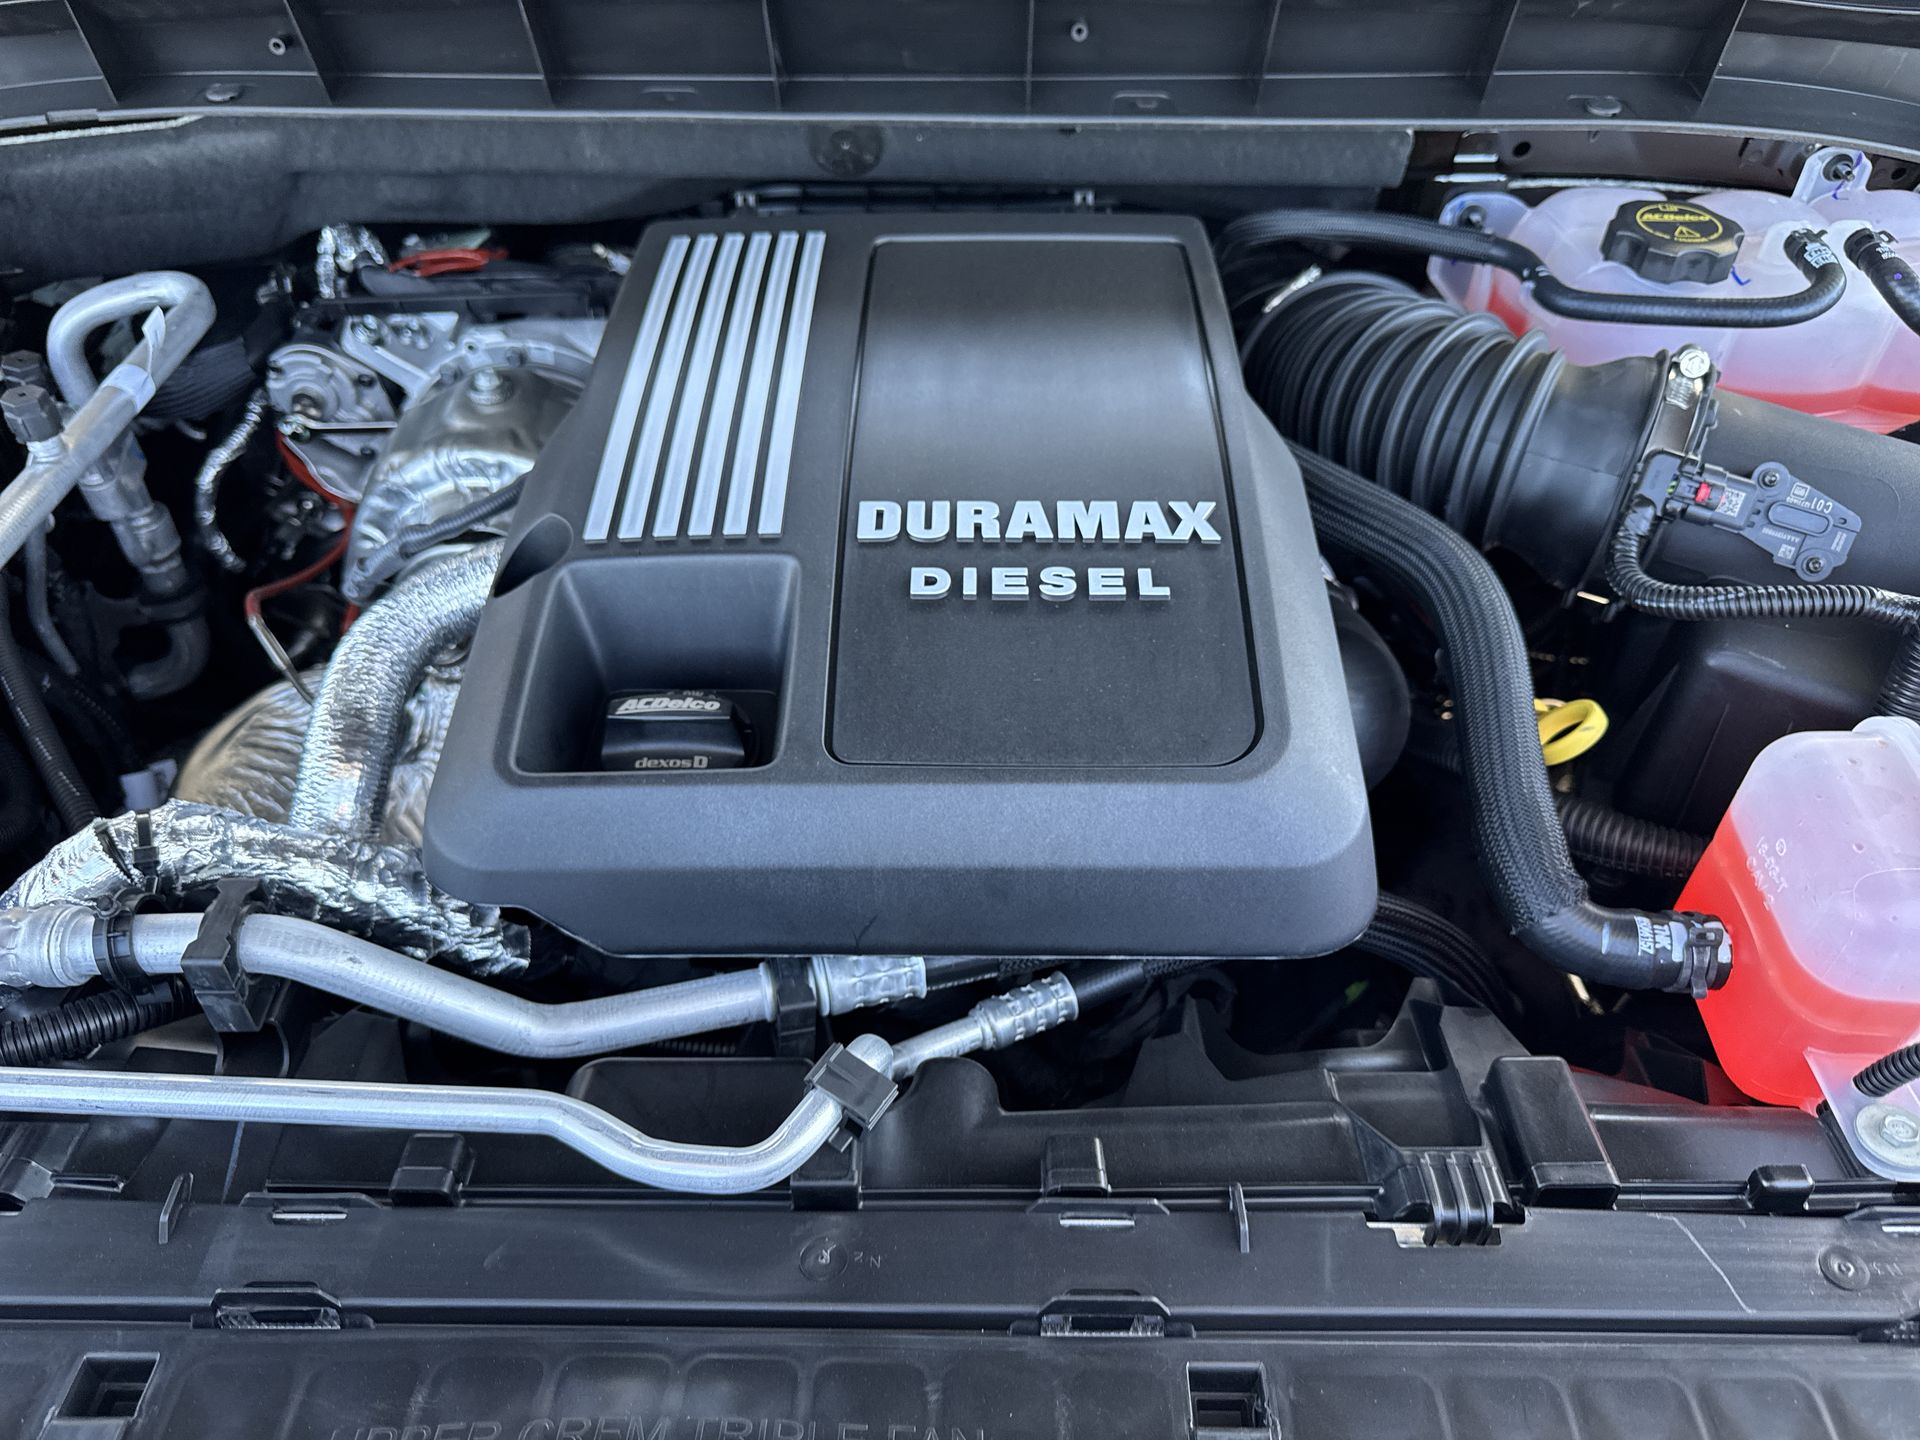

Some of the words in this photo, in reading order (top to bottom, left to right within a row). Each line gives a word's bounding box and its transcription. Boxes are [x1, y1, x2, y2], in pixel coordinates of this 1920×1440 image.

[857, 500, 1221, 543] DURAMAX
[910, 566, 1170, 599] DIESEL
[615, 697, 721, 713] ACDelco
